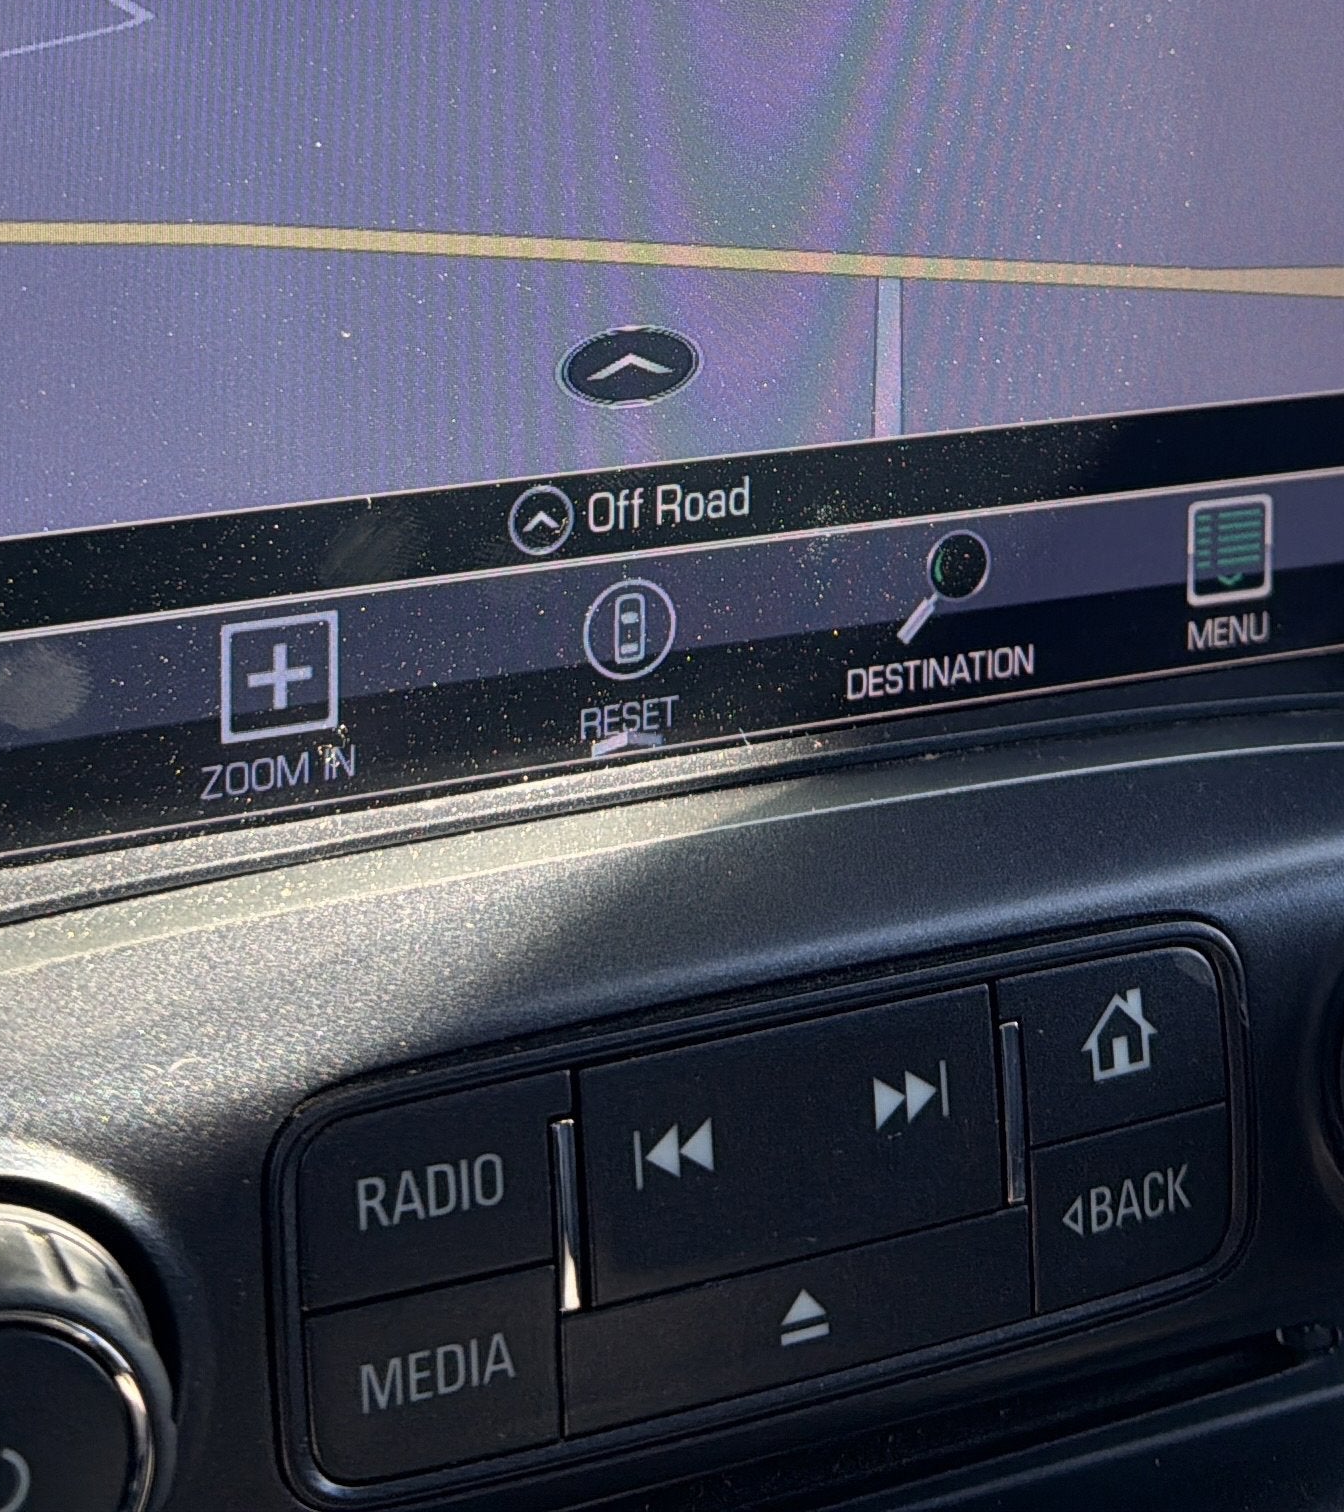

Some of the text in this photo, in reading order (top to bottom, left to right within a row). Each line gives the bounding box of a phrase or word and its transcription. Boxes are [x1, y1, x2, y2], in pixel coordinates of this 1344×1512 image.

[587, 477, 751, 534] Off Road
[1188, 613, 1270, 652] MENU
[846, 644, 1035, 701] DESTINATION
[579, 695, 679, 741] RESET
[200, 744, 355, 801] ZOOM IN
[356, 1152, 504, 1232] RADIO
[1089, 1164, 1192, 1235] BACK
[359, 1332, 517, 1416] MEDIA
